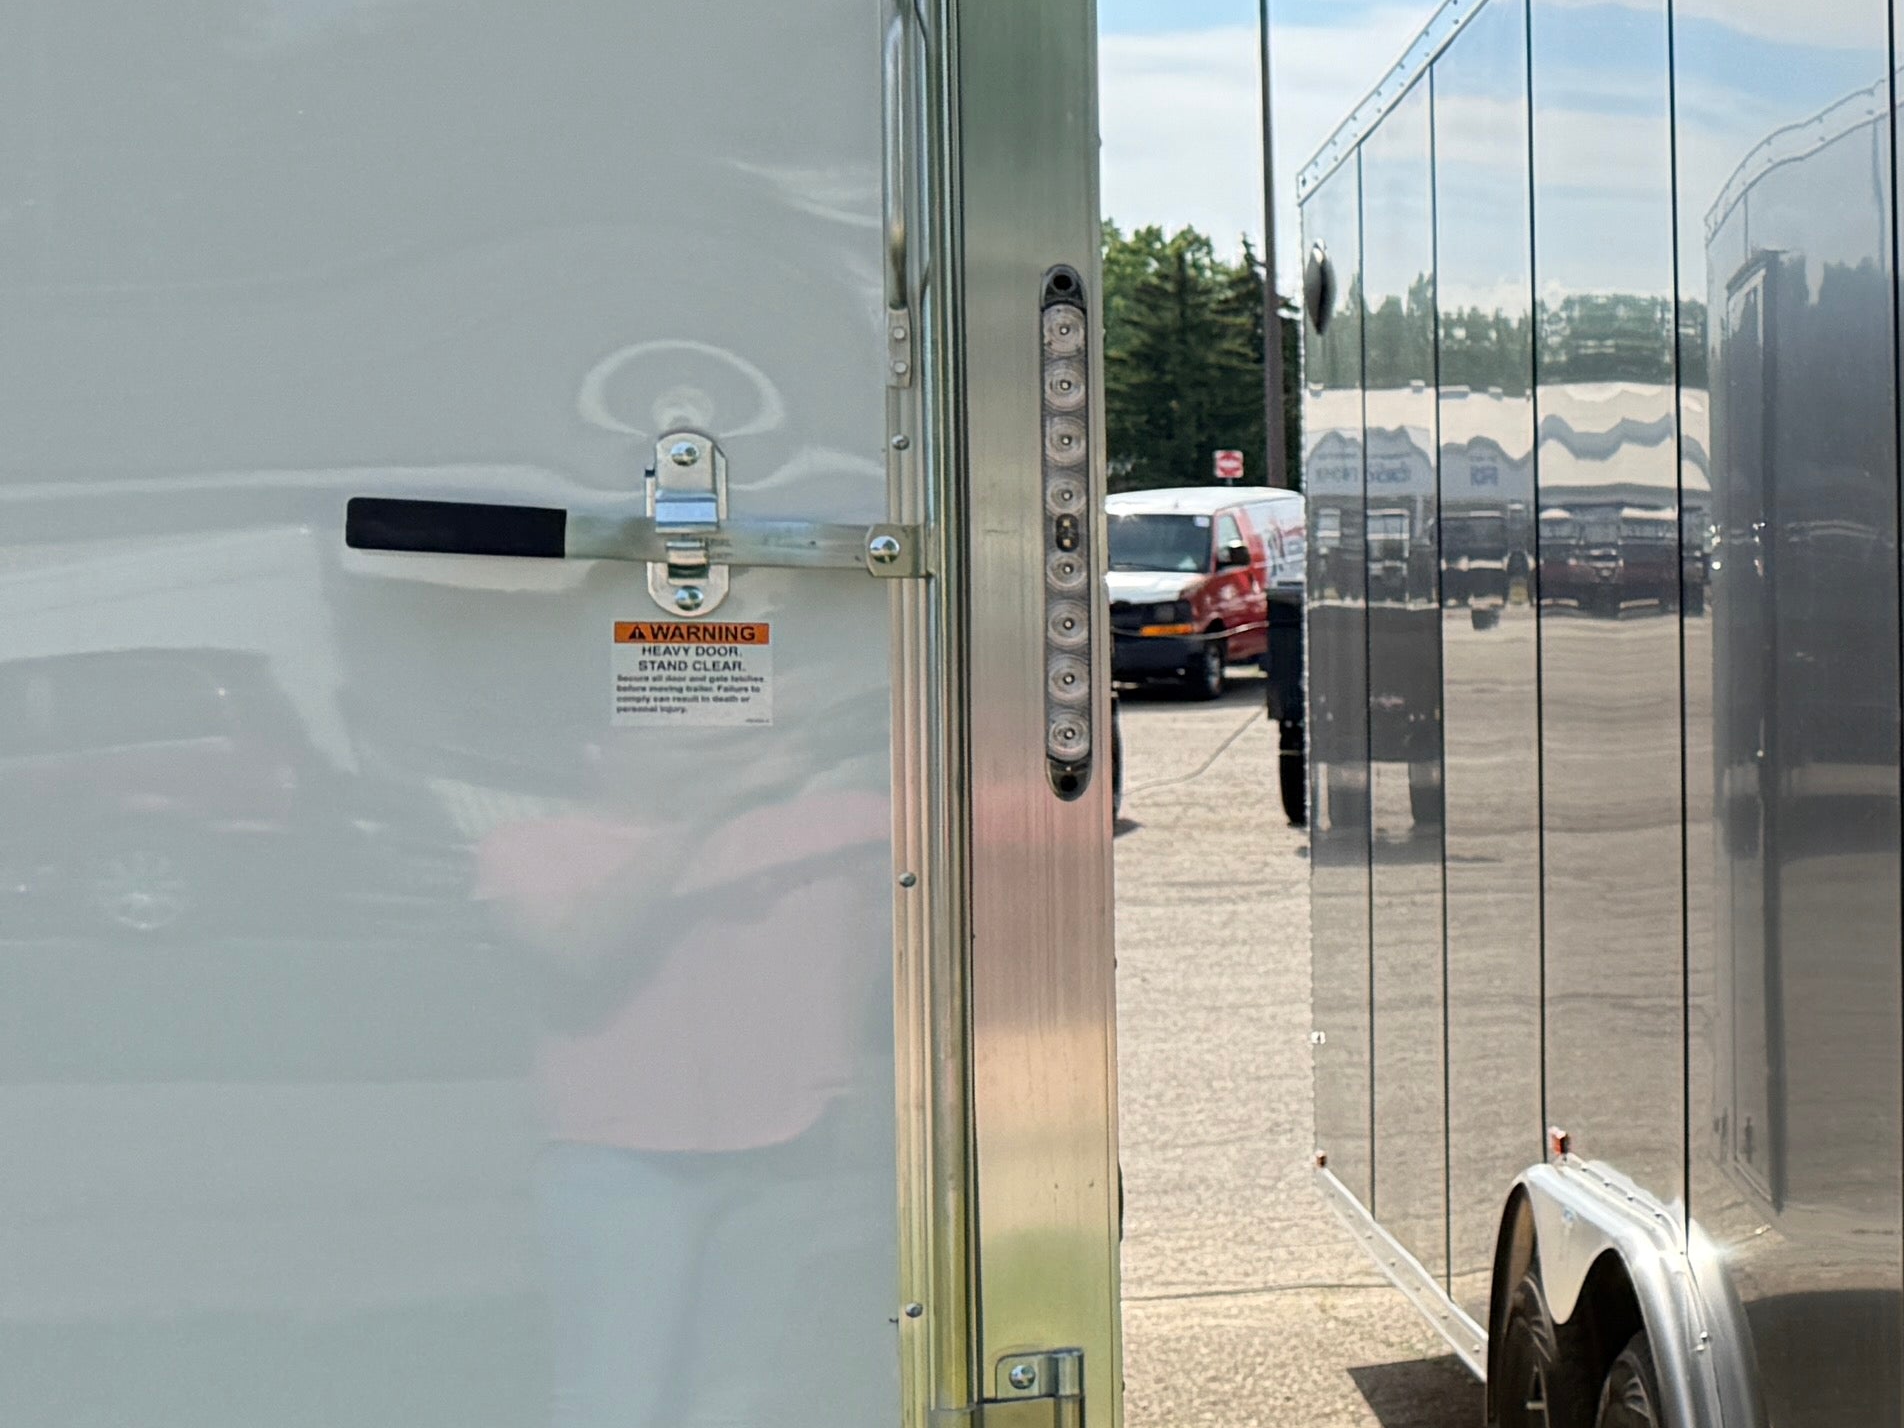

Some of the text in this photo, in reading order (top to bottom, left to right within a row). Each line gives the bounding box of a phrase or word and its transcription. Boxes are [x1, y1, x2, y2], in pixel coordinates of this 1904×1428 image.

[650, 625, 756, 641] WARNING
[642, 646, 691, 657] HEAVY
[639, 660, 688, 672] STAND
